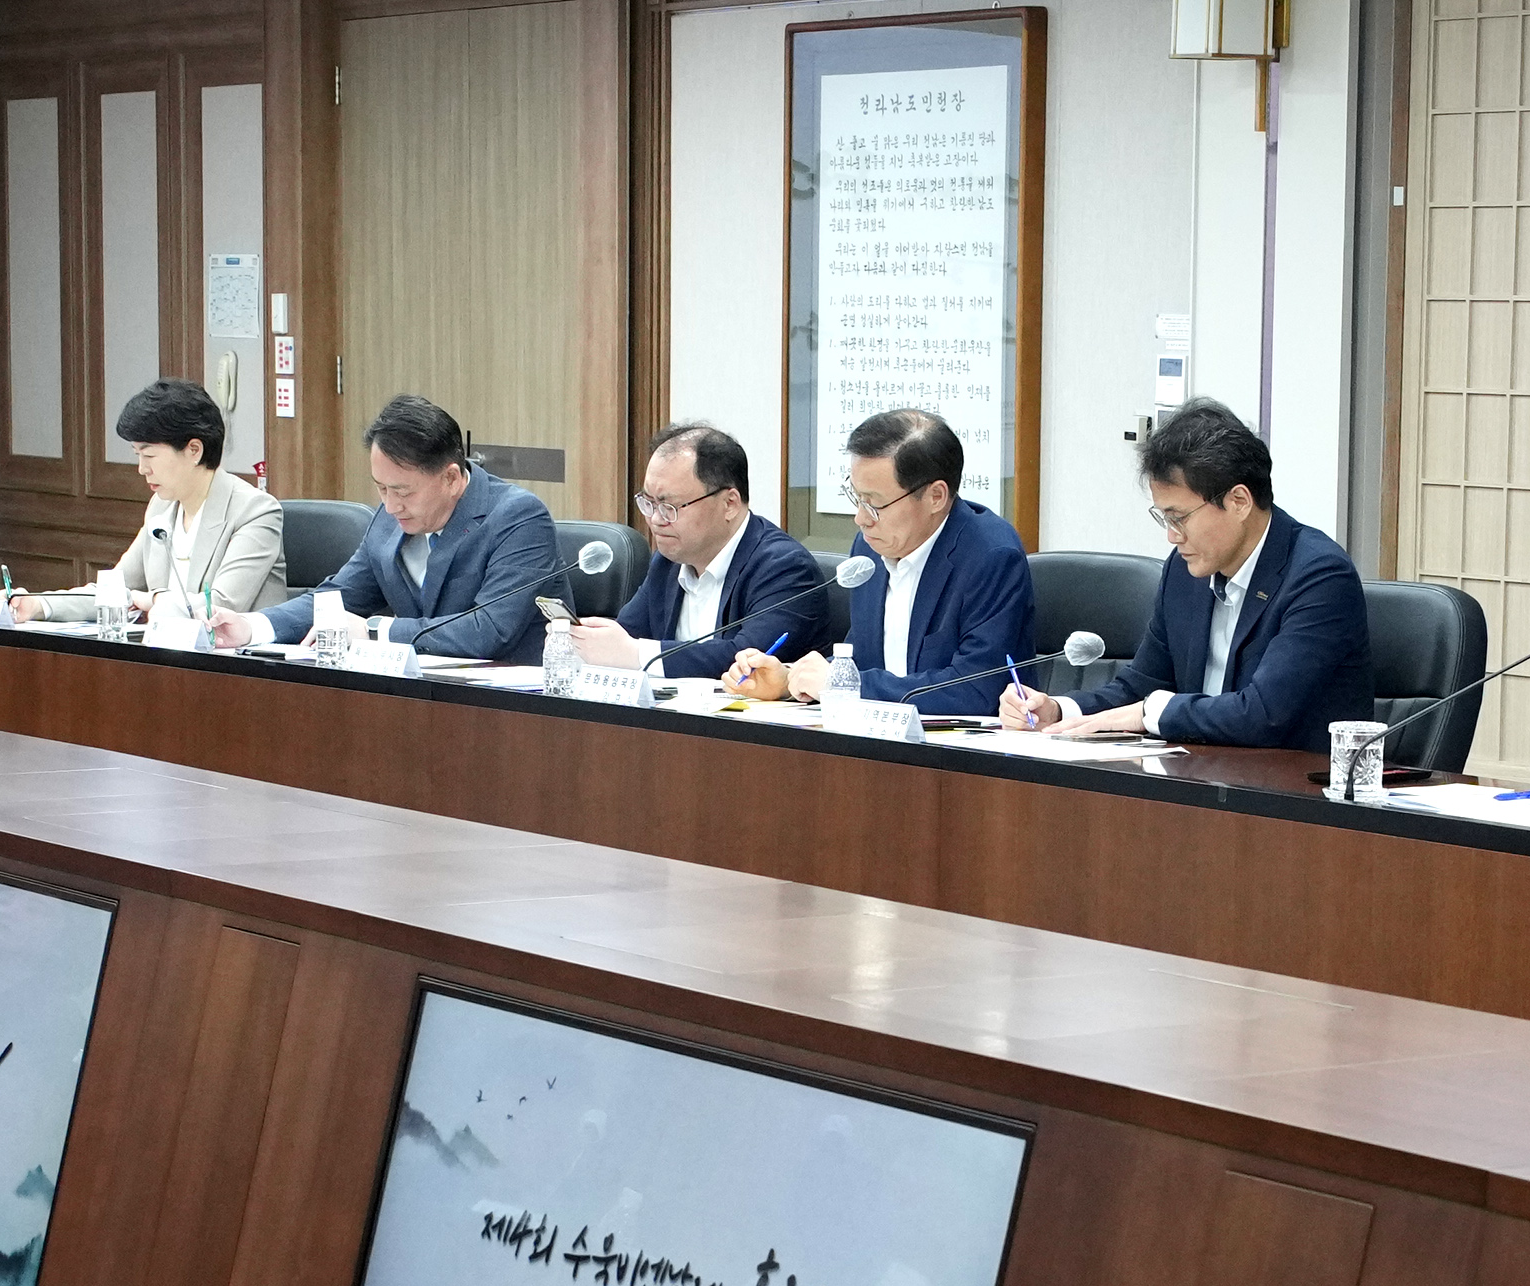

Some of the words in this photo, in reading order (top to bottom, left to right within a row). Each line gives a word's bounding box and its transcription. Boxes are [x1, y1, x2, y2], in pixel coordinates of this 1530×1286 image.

[860, 90, 965, 115] 전라남도민헌장
[902, 133, 918, 149] 우리
[943, 152, 979, 167] 고장이다
[835, 178, 857, 194] 우리의
[829, 198, 851, 213] 나라와
[920, 196, 945, 212] 구하고
[835, 241, 857, 257] 우리는
[861, 241, 869, 257] 이
[480, 1209, 558, 1265] 제4회
